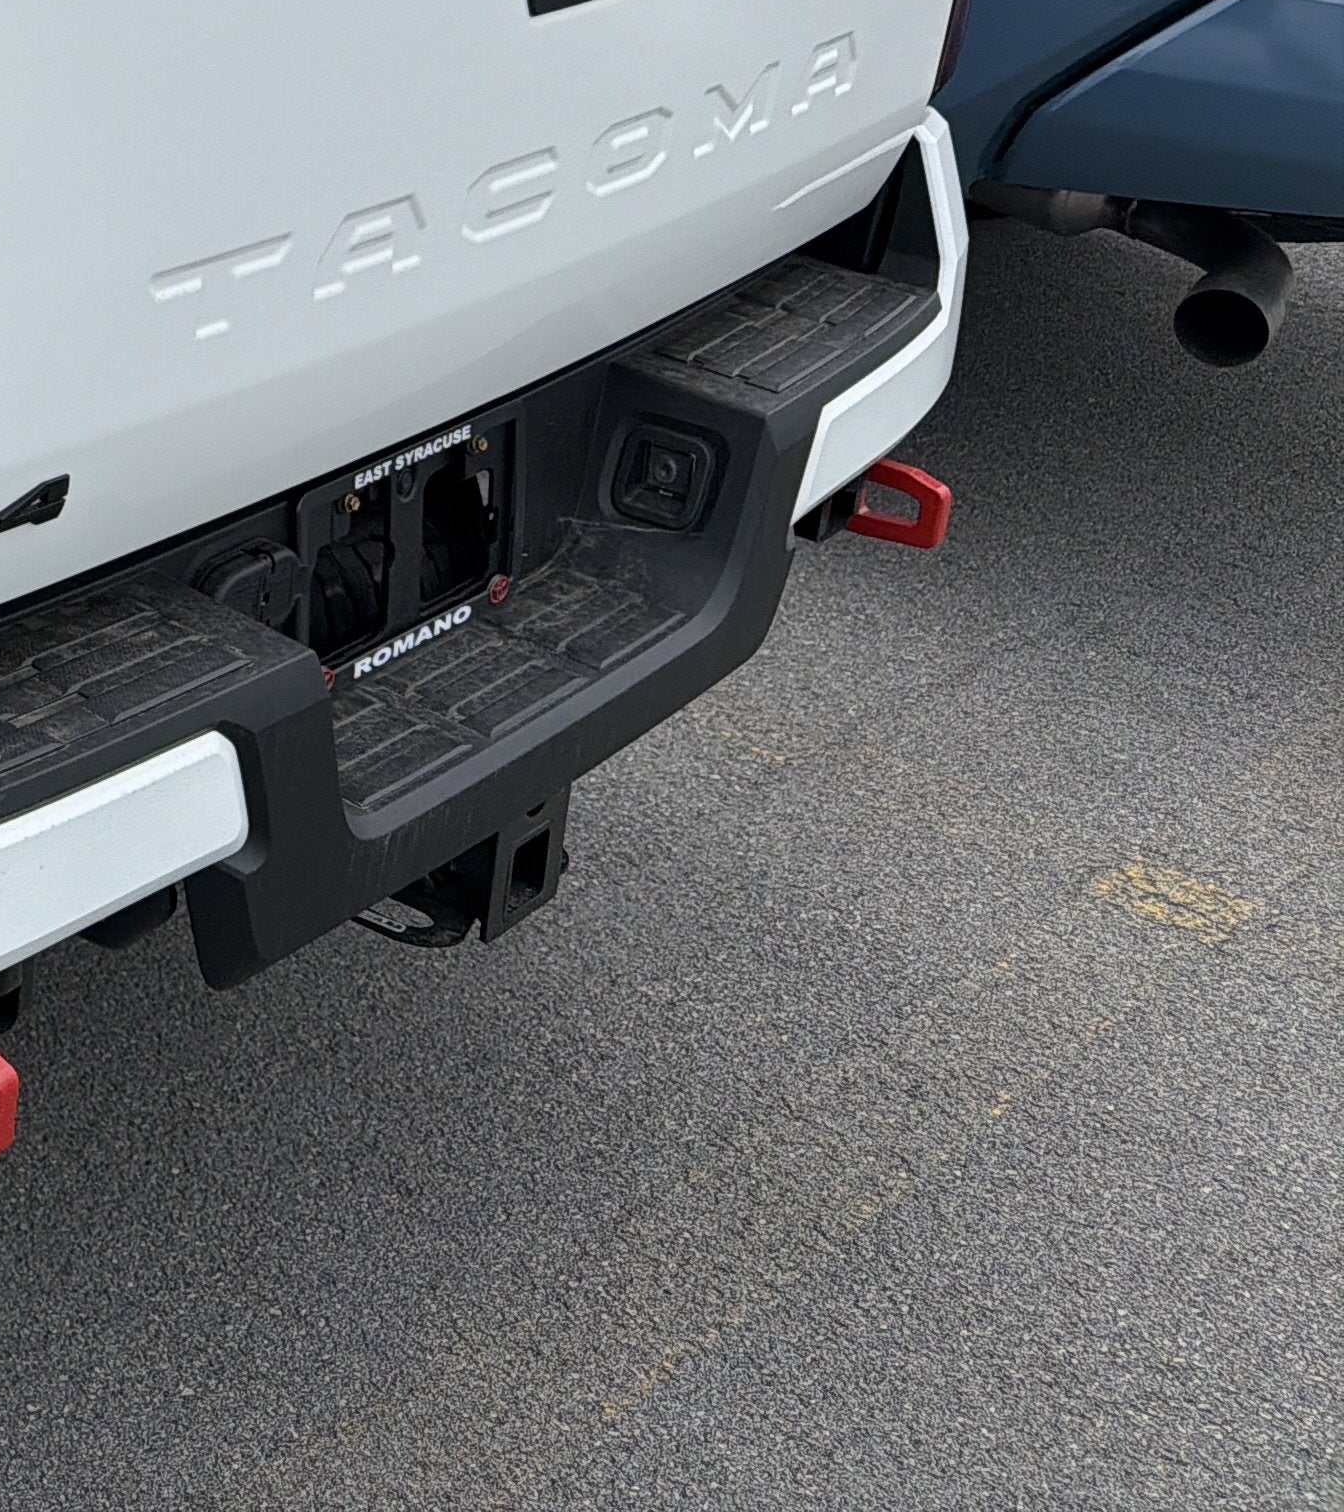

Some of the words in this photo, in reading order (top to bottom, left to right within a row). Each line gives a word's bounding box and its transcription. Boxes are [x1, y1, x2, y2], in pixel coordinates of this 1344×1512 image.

[149, 30, 859, 341] TACOMA
[354, 460, 393, 490] EAST
[394, 424, 473, 471] SYRACUSE
[353, 605, 473, 680] ROMANO
